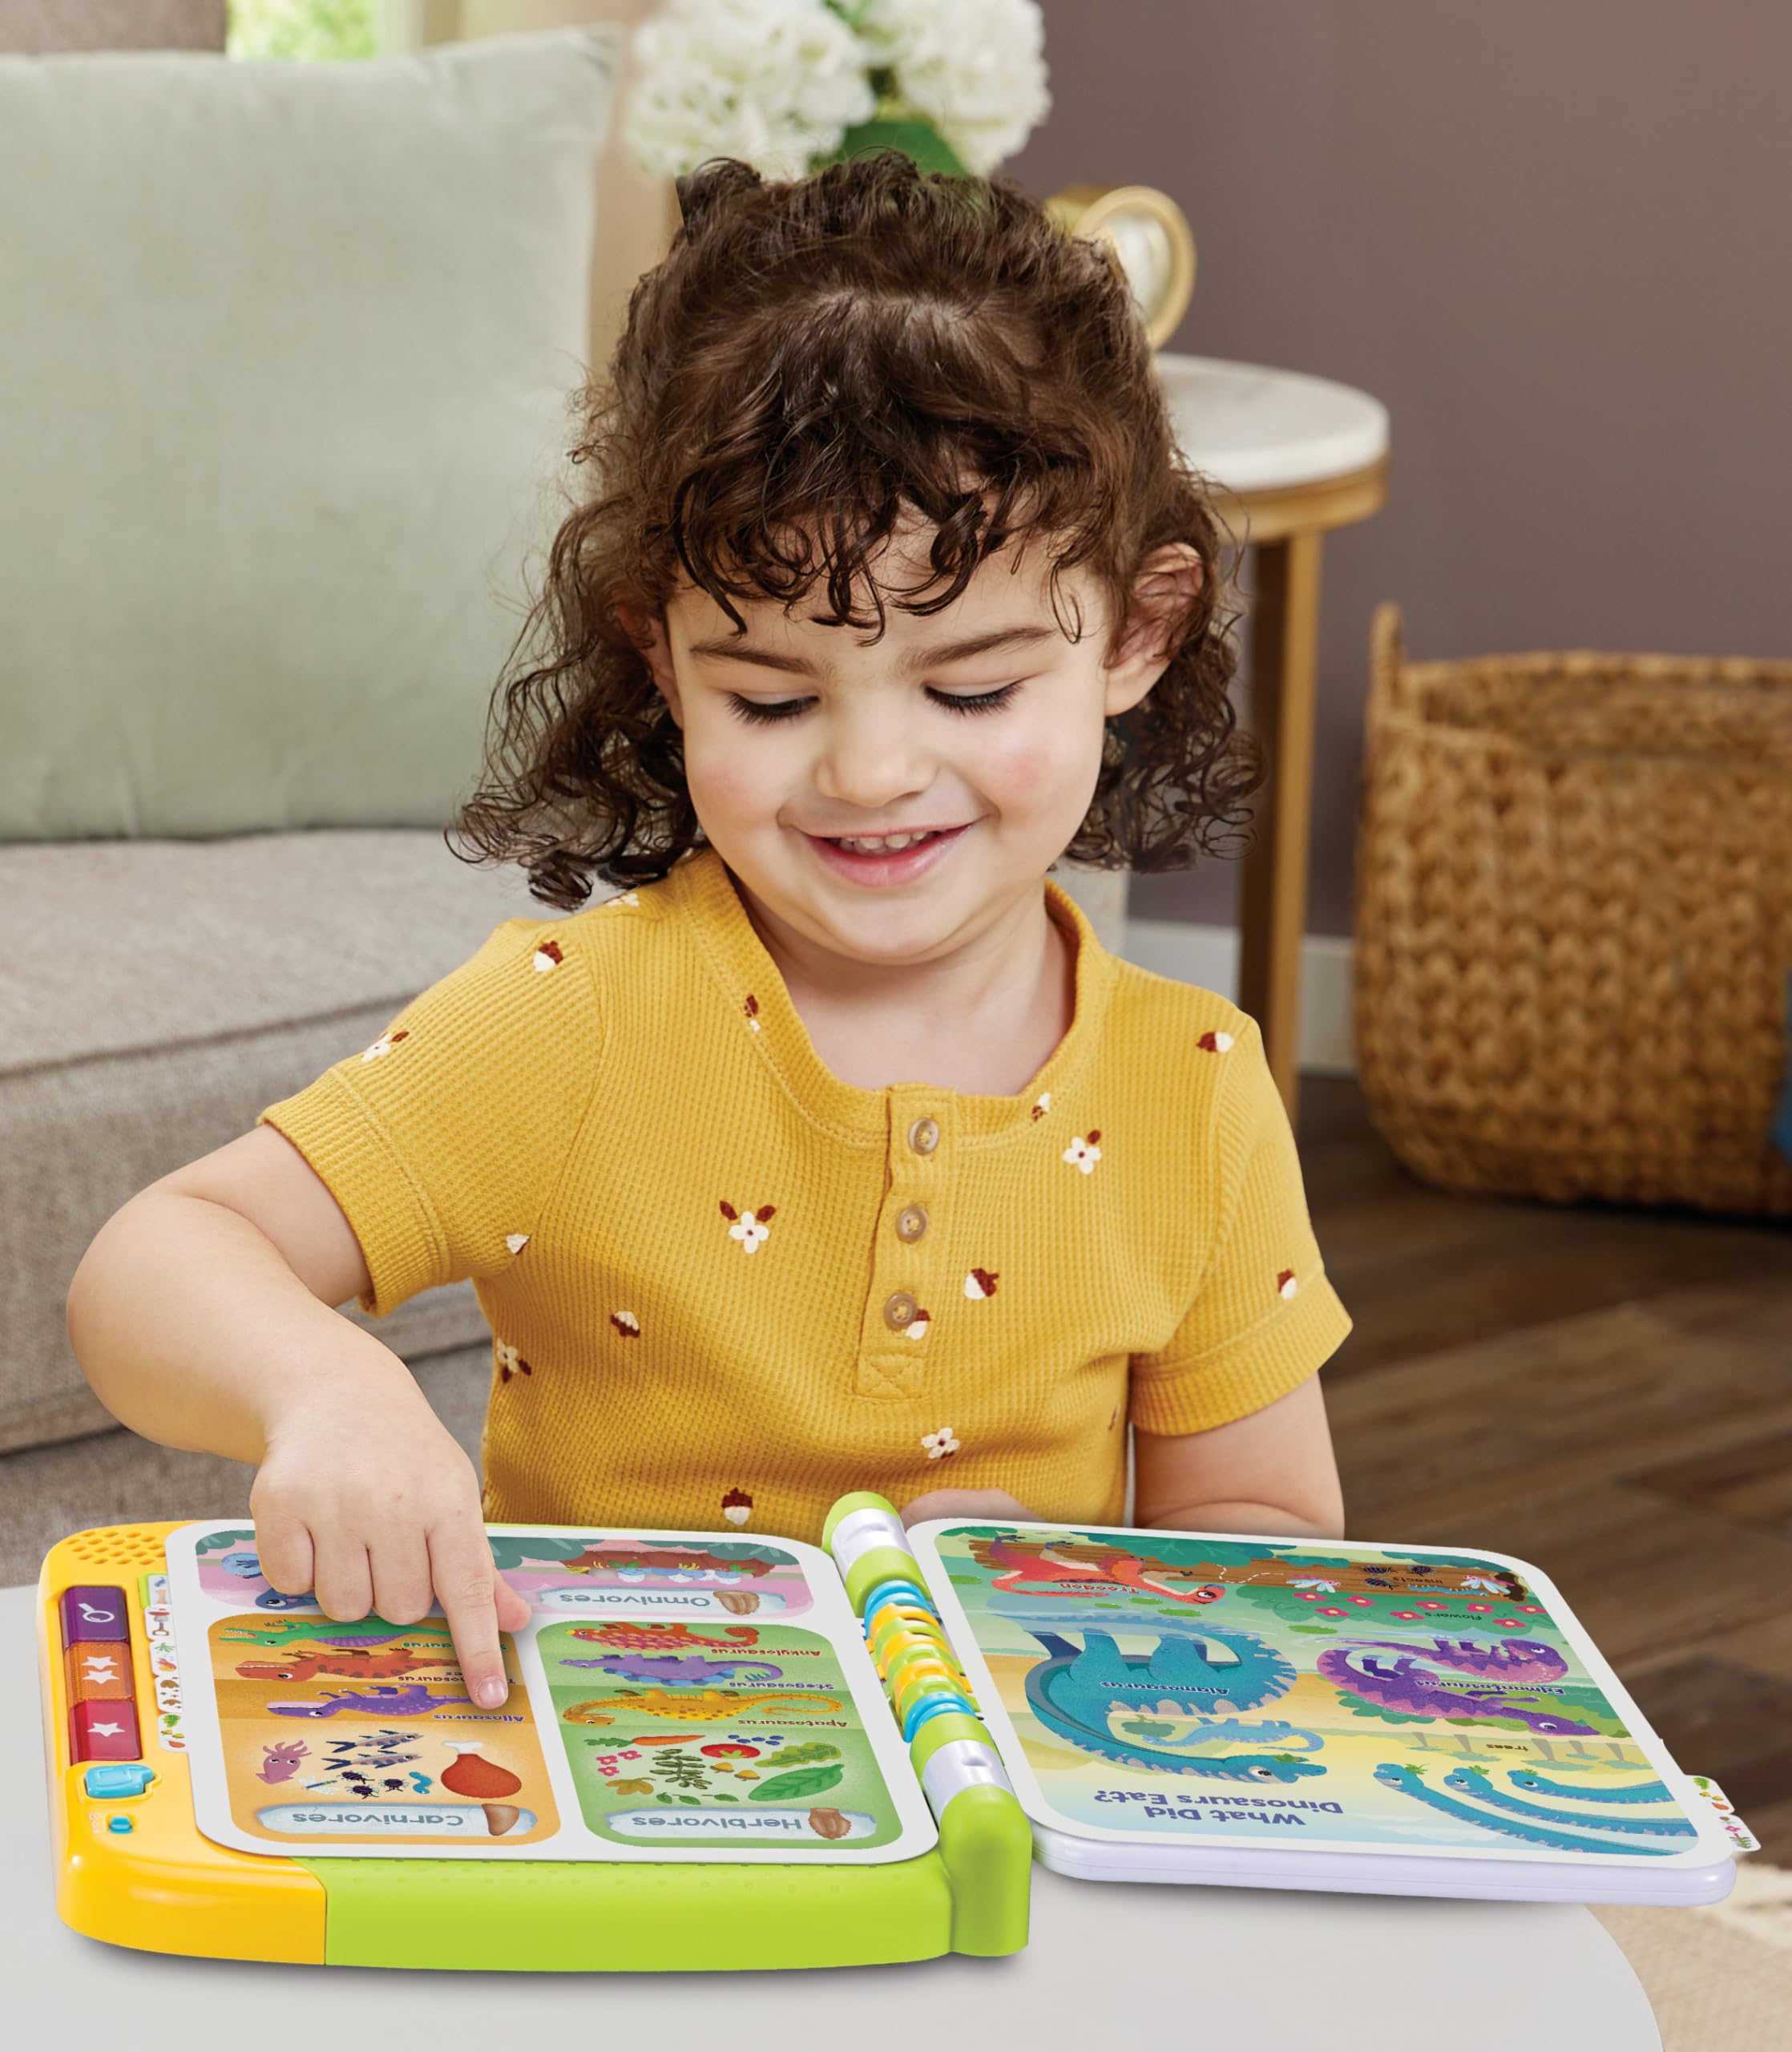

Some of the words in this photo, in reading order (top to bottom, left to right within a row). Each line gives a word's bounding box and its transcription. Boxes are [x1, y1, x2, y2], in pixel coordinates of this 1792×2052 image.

[1059, 1583, 1140, 1594] Troodon
[559, 1594, 710, 1606] Omnivores
[1425, 1611, 1482, 1620] flowers
[711, 1649, 821, 1657] Ankylosaurus
[398, 1675, 516, 1683] Tnosaurus
[1100, 1682, 1229, 1695] Alamosaurus
[1415, 1680, 1565, 1695] Edmontosaurus
[433, 1714, 526, 1723] Allosaurus
[738, 1719, 847, 1727] Apatosaurus
[1486, 1743, 1529, 1751] trees
[1095, 1790, 1168, 1805] Eat?
[1177, 1795, 1344, 1814] Dinosaurs
[1144, 1806, 1202, 1820] Did
[1209, 1809, 1307, 1826] What
[292, 1812, 464, 1827] Carnivores
[632, 1816, 802, 1830] Herbivores
